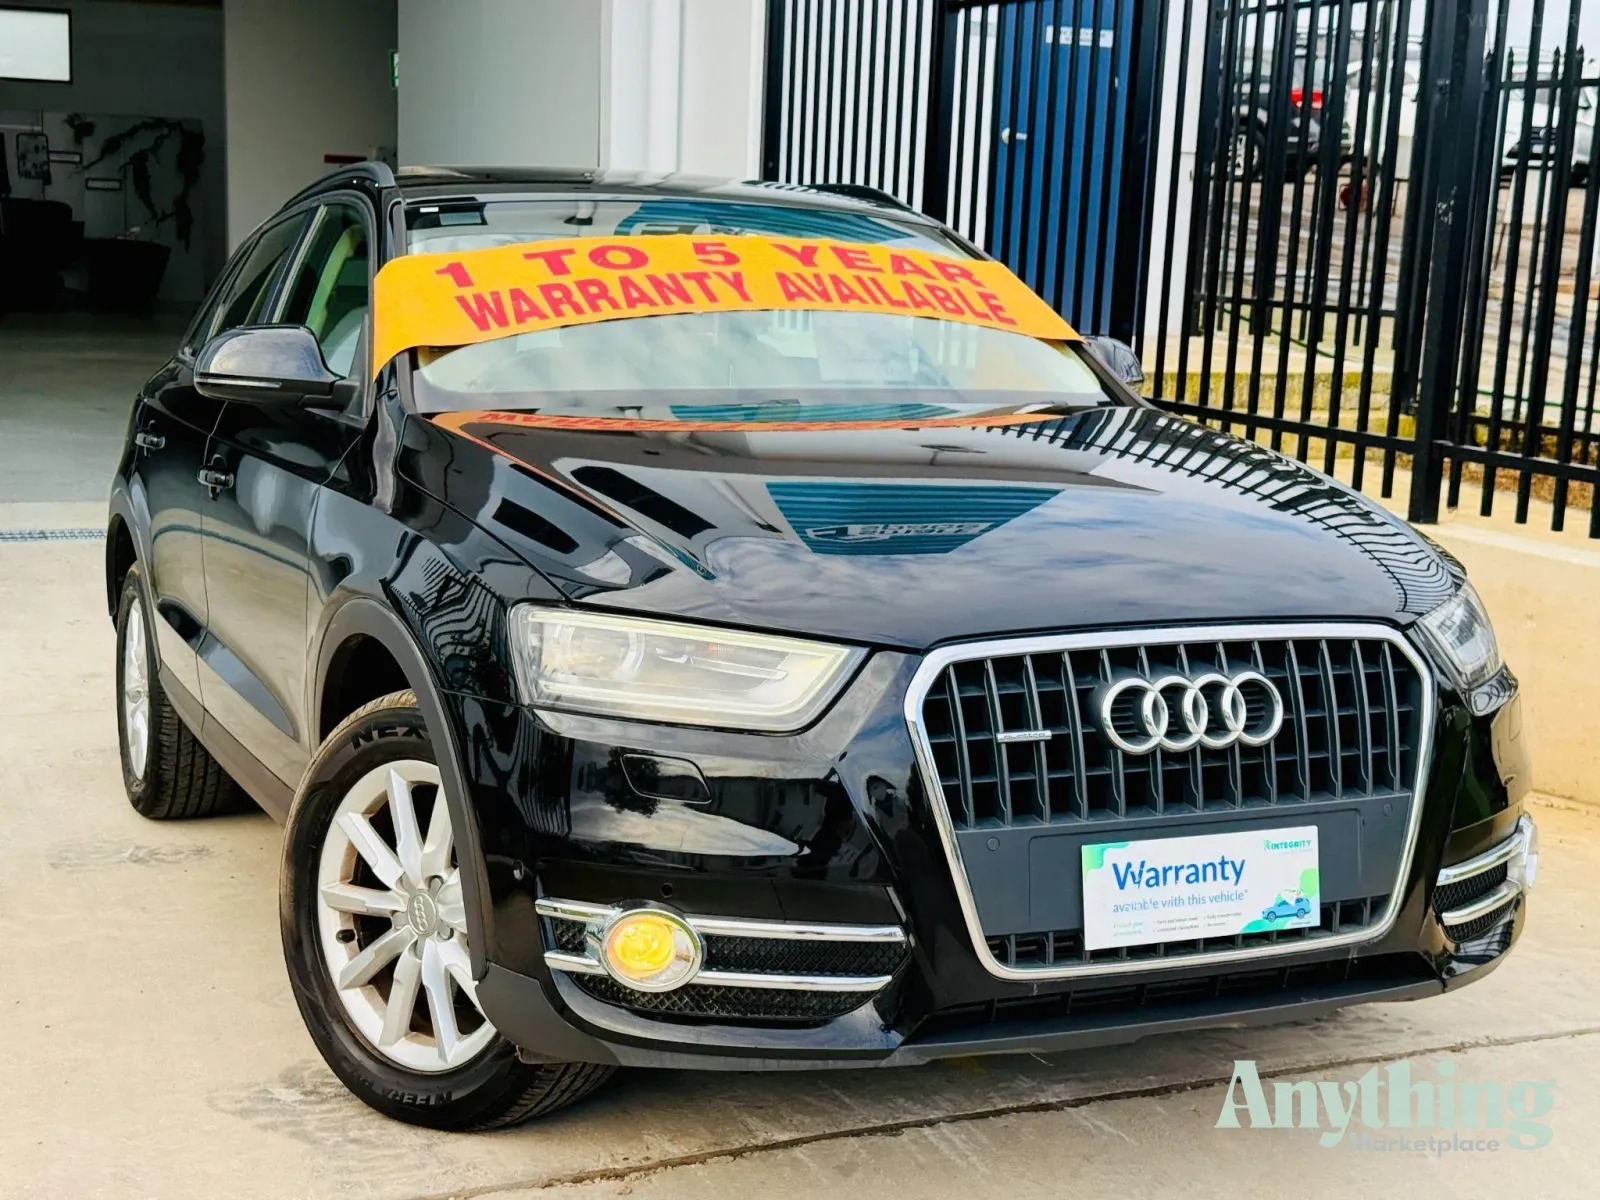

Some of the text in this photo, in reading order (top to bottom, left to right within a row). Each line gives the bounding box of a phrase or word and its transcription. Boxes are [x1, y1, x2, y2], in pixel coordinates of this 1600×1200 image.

[434, 241, 987, 288] 1 TO 5 YEAR
[454, 270, 1017, 332] WARRANTY AVAILABLE
[350, 719, 429, 750] NEX
[1271, 839, 1312, 850] INTEGRITY
[1111, 855, 1246, 891] Warranty
[1161, 894, 1185, 908] with
[1187, 891, 1206, 905] this
